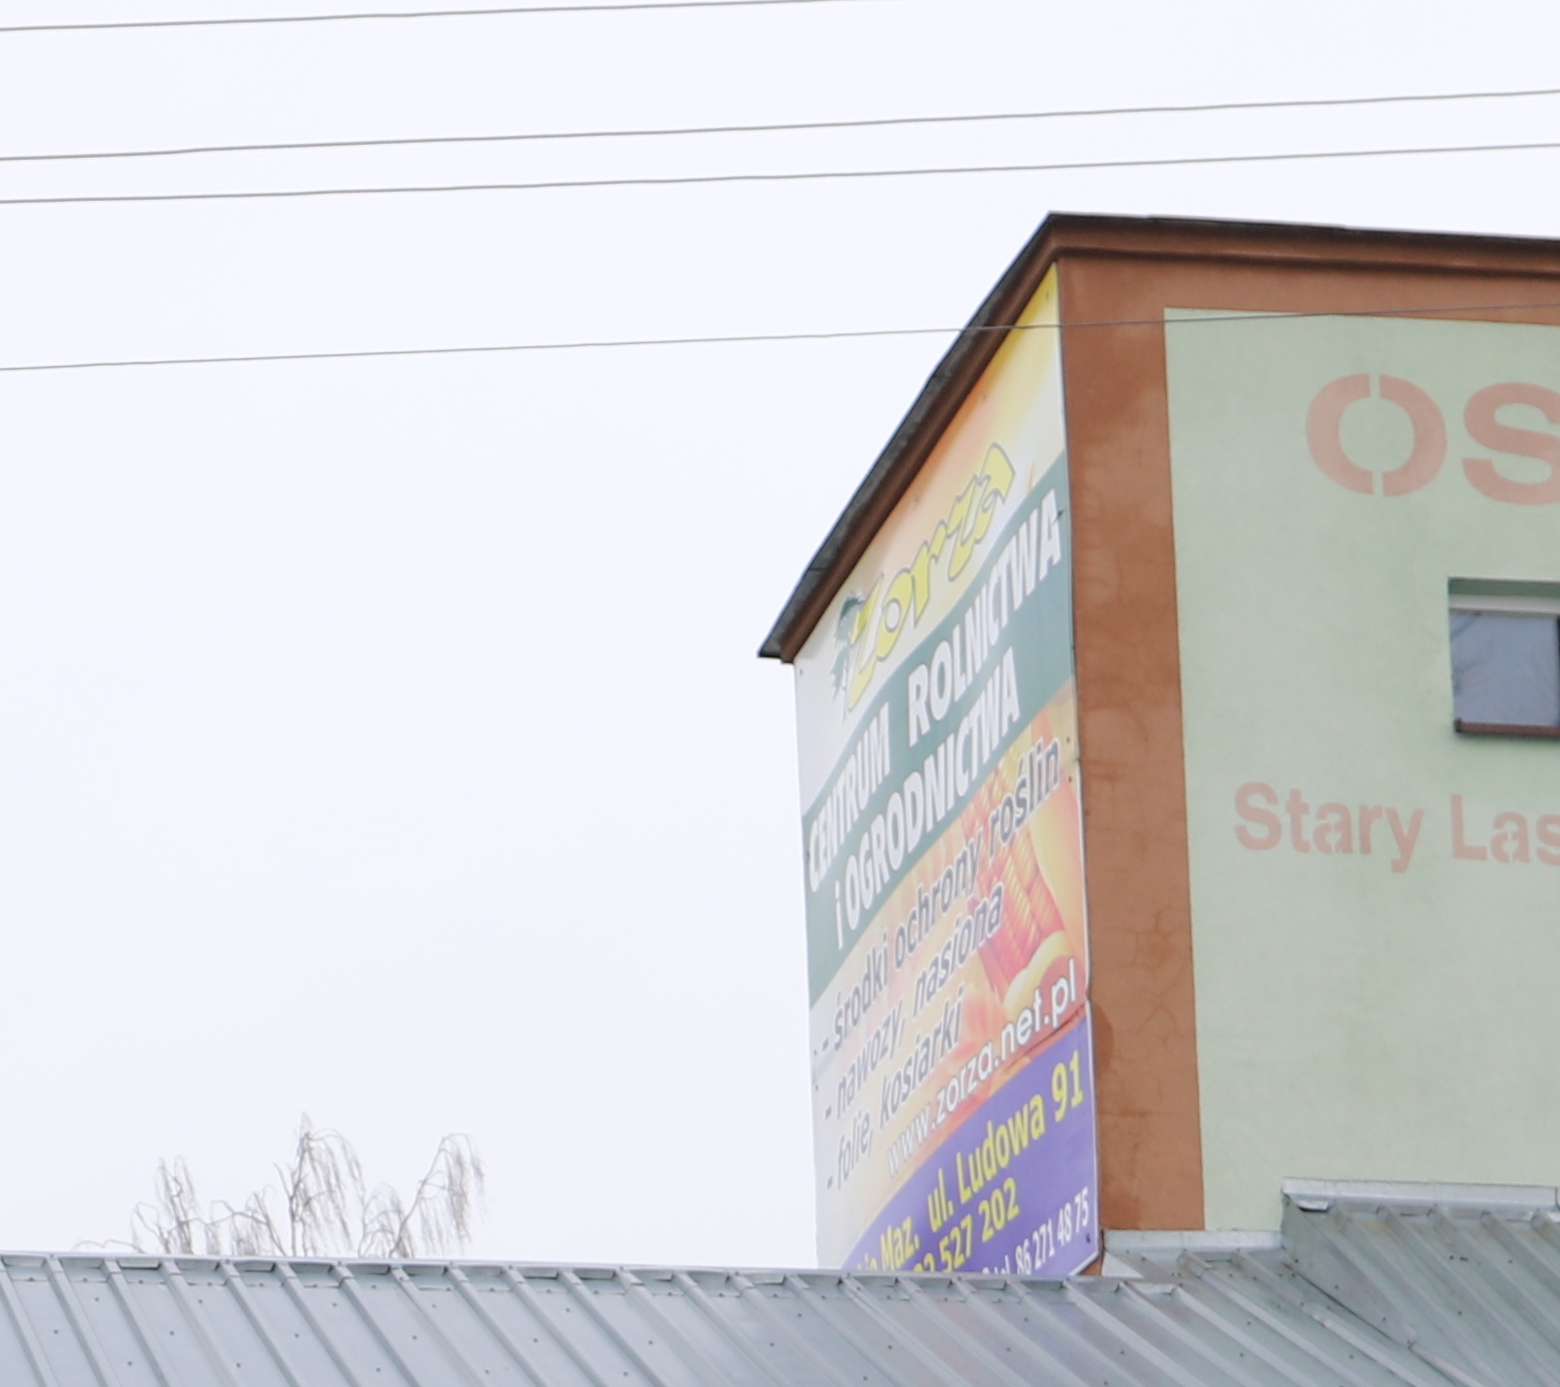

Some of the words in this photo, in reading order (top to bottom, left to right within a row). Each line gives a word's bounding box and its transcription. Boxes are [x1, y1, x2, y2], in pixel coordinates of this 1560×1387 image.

[808, 702, 890, 893] CENTRUM
[908, 488, 1061, 748] ROLNICTWA
[845, 646, 1021, 930] OGRODNICTWA
[1233, 780, 1424, 874] Stary
[833, 926, 888, 1051] środki
[894, 826, 983, 970] ochrony
[988, 736, 1061, 860] roślin
[912, 882, 1003, 1019] nasiona
[880, 981, 965, 1131] kosiarki
[888, 957, 1078, 1178] www.zorza.net.pl
[927, 1168, 954, 1233] ul.
[956, 1094, 1046, 1204] Ludowa
[1051, 1050, 1085, 1122] 91
[979, 1177, 1020, 1242] 202
[1033, 1219, 1055, 1269] 271
[1057, 1202, 1071, 1245] 48
[1075, 1186, 1089, 1233] 75
